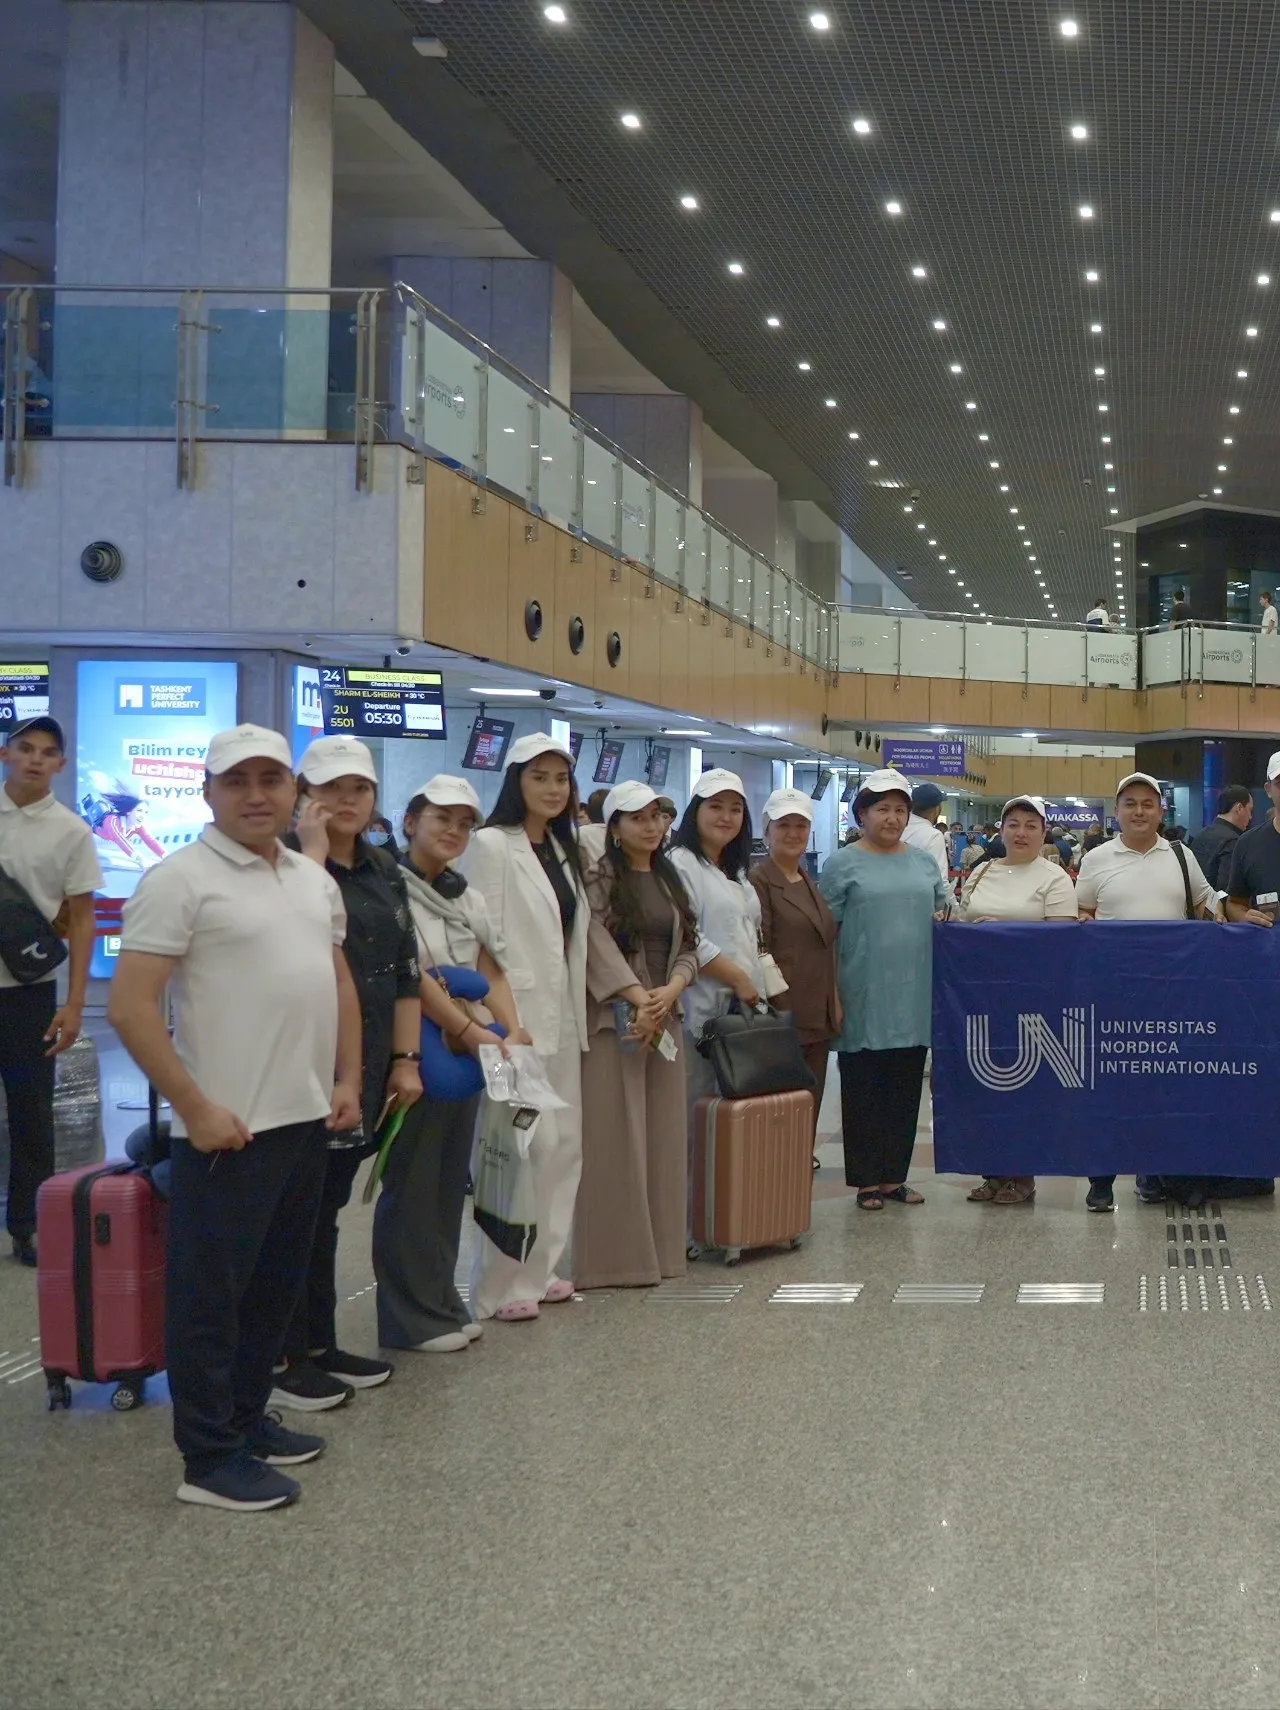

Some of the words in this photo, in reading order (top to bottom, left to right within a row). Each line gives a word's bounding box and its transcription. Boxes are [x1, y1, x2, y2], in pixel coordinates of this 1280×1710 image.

[322, 669, 341, 682] 24
[365, 673, 400, 681] BUSINESS
[151, 685, 192, 693] TASHKENT
[334, 689, 361, 697] SHARM
[362, 690, 401, 699] EL-SHEIKH
[152, 693, 185, 701] PERFECT
[152, 701, 200, 709] UNIVERSITY
[333, 705, 349, 715] 2U
[364, 702, 400, 711] Departure
[330, 718, 354, 728] 5501
[365, 712, 402, 725] 05:30
[128, 743, 172, 757] Bilim
[177, 746, 208, 759] rey
[1100, 1021, 1217, 1035] UNIVERSITAS
[1100, 1041, 1179, 1055] NORDICA
[1100, 1060, 1258, 1076] INTERNATIONALIS
